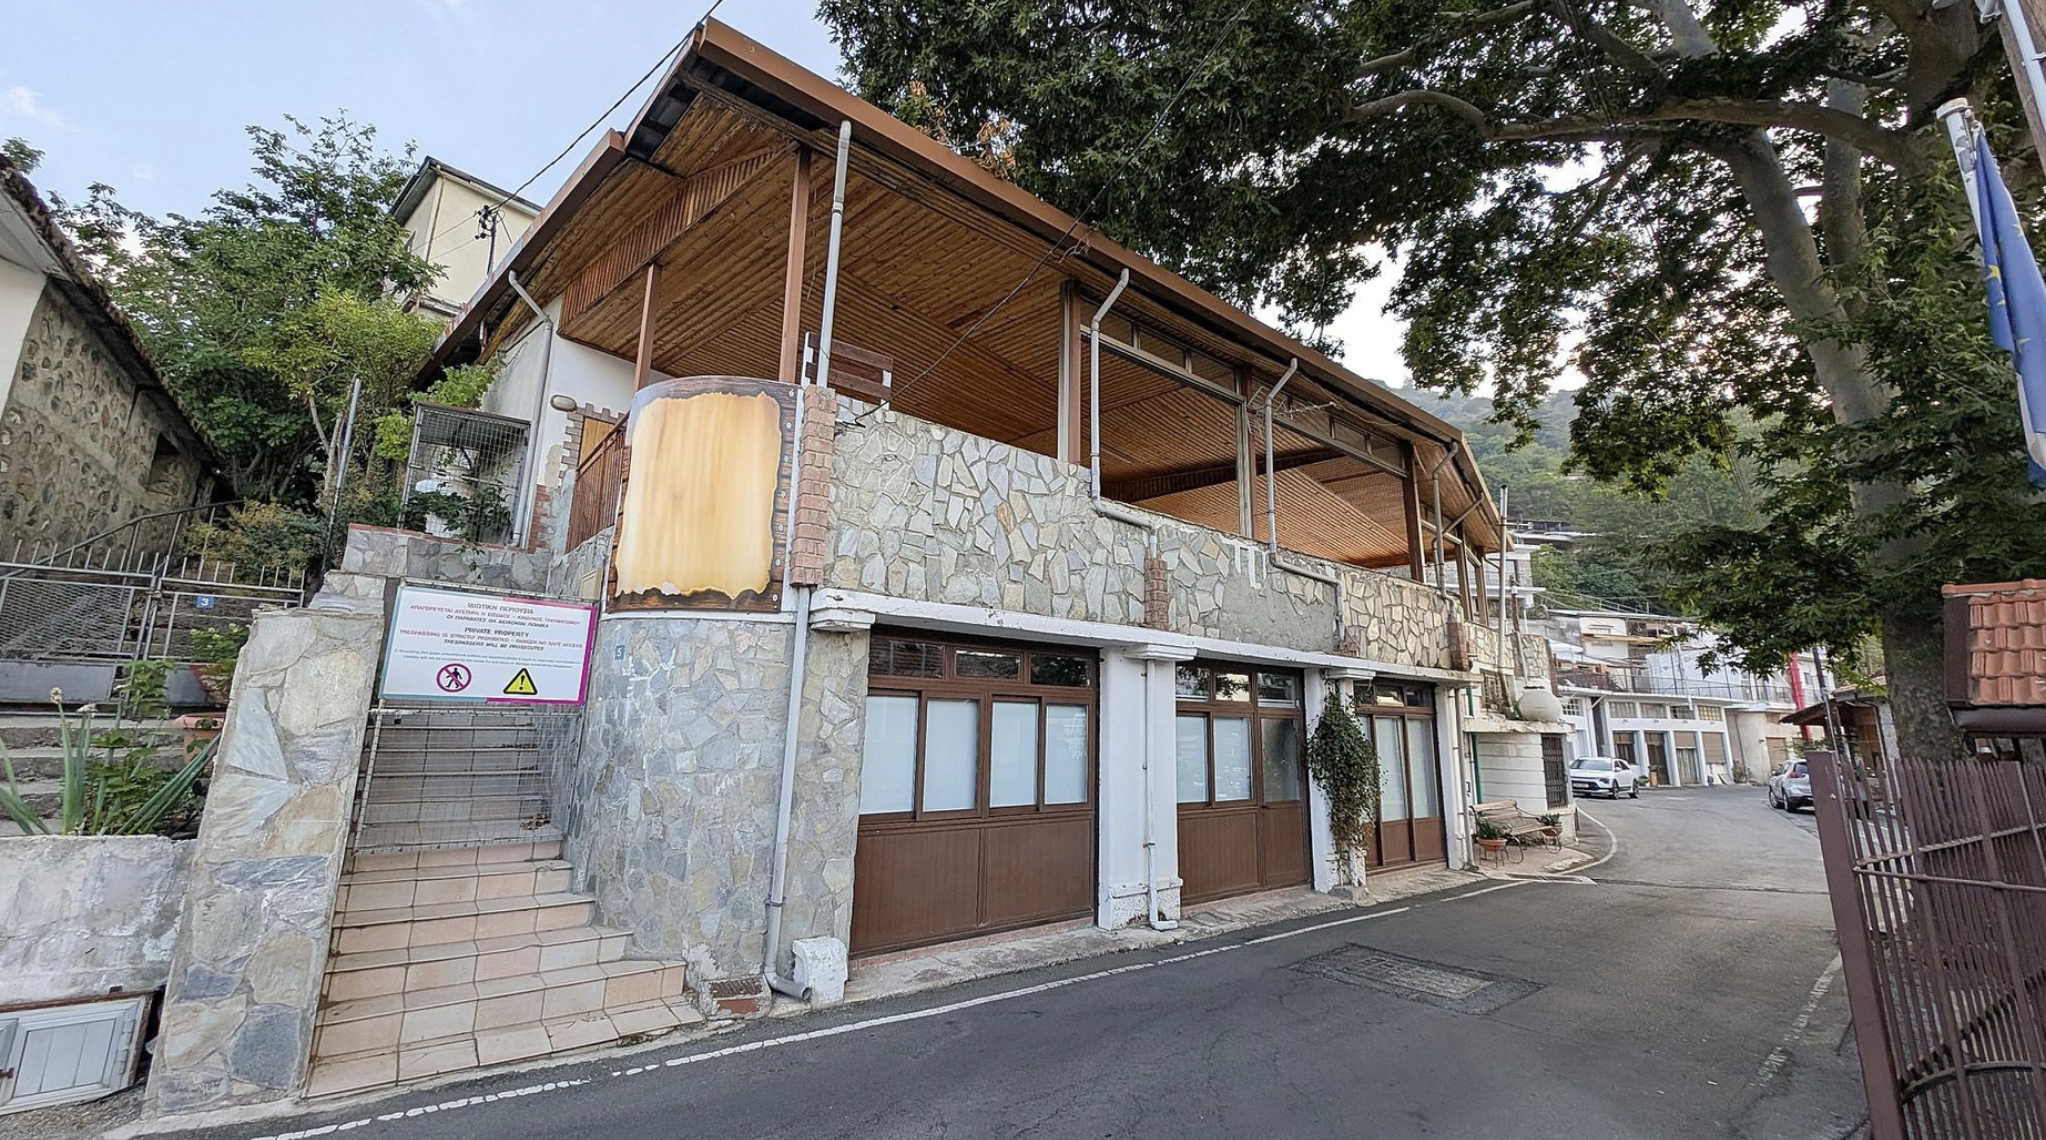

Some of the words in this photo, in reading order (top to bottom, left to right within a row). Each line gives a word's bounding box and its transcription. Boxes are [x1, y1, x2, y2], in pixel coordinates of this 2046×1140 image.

[201, 598, 209, 606] 3
[400, 629, 440, 637] TRESPASSING
[494, 629, 529, 637] PROPERTY
[617, 647, 622, 657] 5
